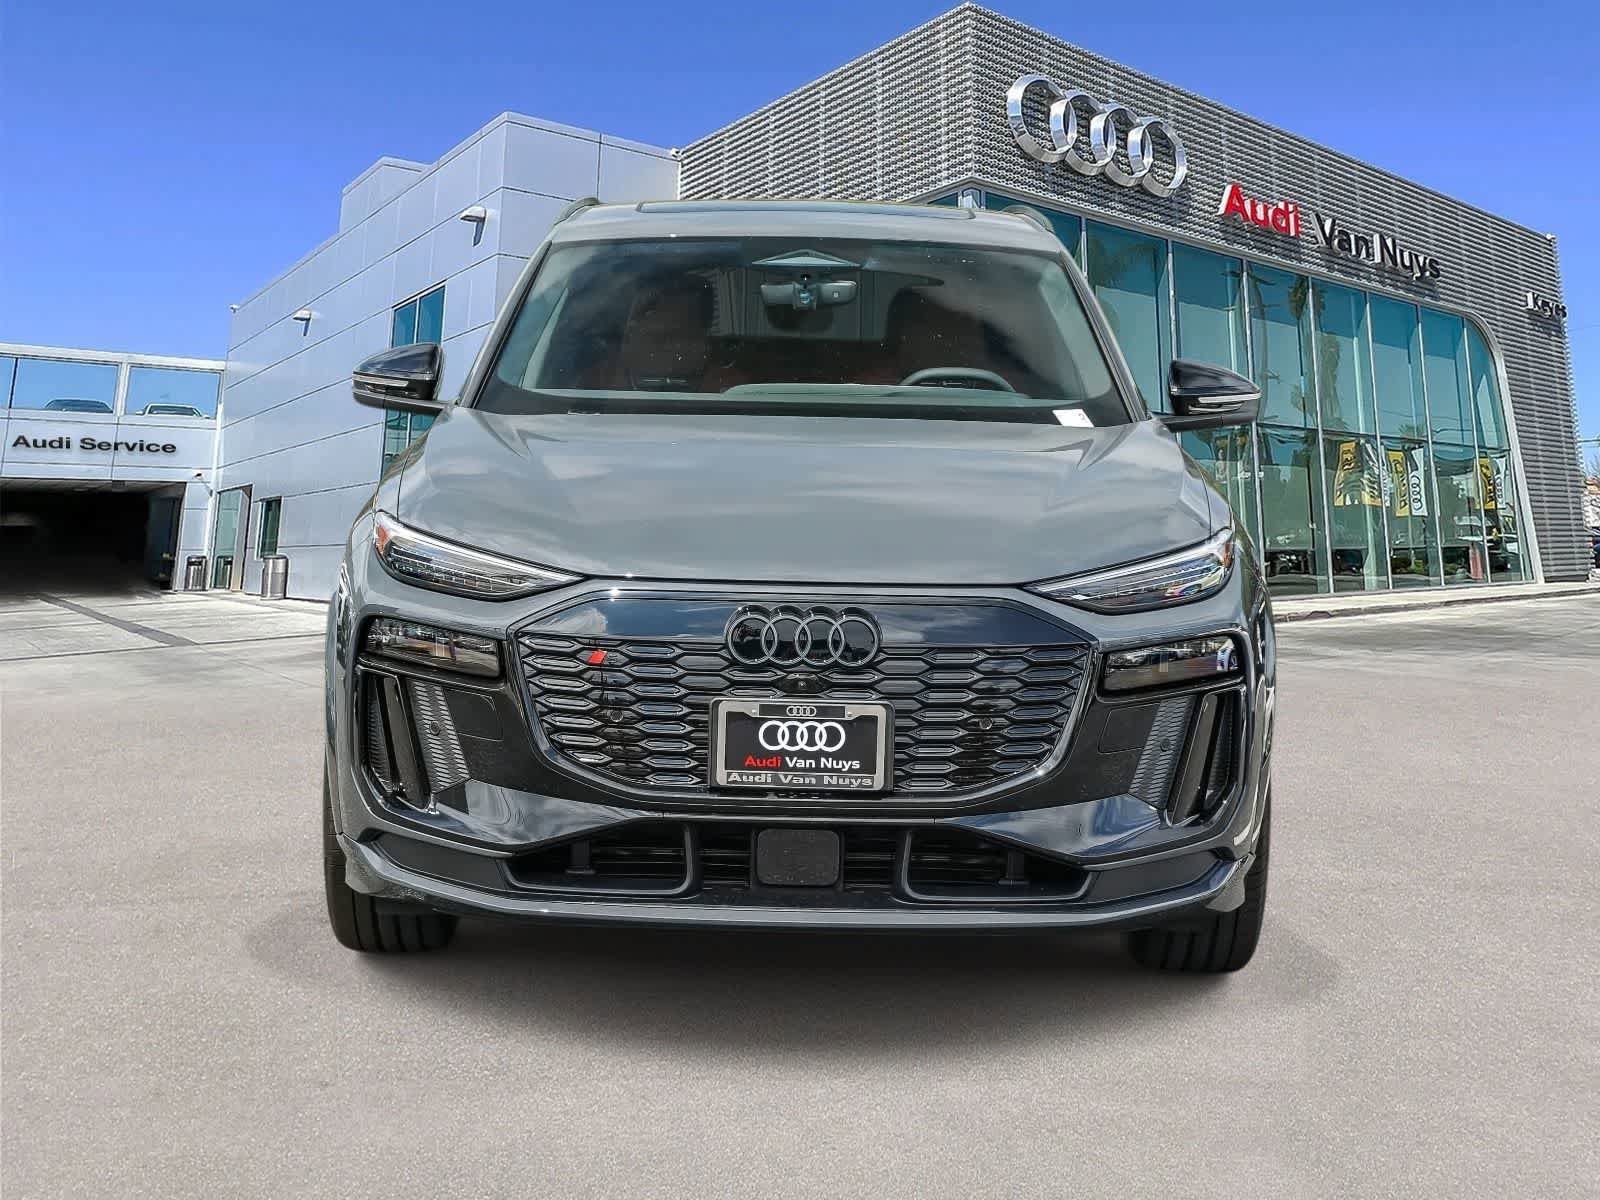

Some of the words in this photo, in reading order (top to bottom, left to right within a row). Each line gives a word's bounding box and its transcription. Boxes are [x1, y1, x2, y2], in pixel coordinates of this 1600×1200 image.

[1217, 183, 1301, 237] Audi
[1311, 213, 1373, 259] Van
[1374, 233, 1441, 280] Nuys
[1526, 292, 1568, 319] Keyes
[12, 435, 71, 449] Audi
[80, 437, 177, 453] Service
[744, 755, 782, 768] Audi
[785, 756, 816, 769] Van
[820, 757, 861, 771] Nuys
[727, 772, 773, 783] Audi
[779, 774, 817, 785] Van
[823, 776, 873, 787] Nuys
